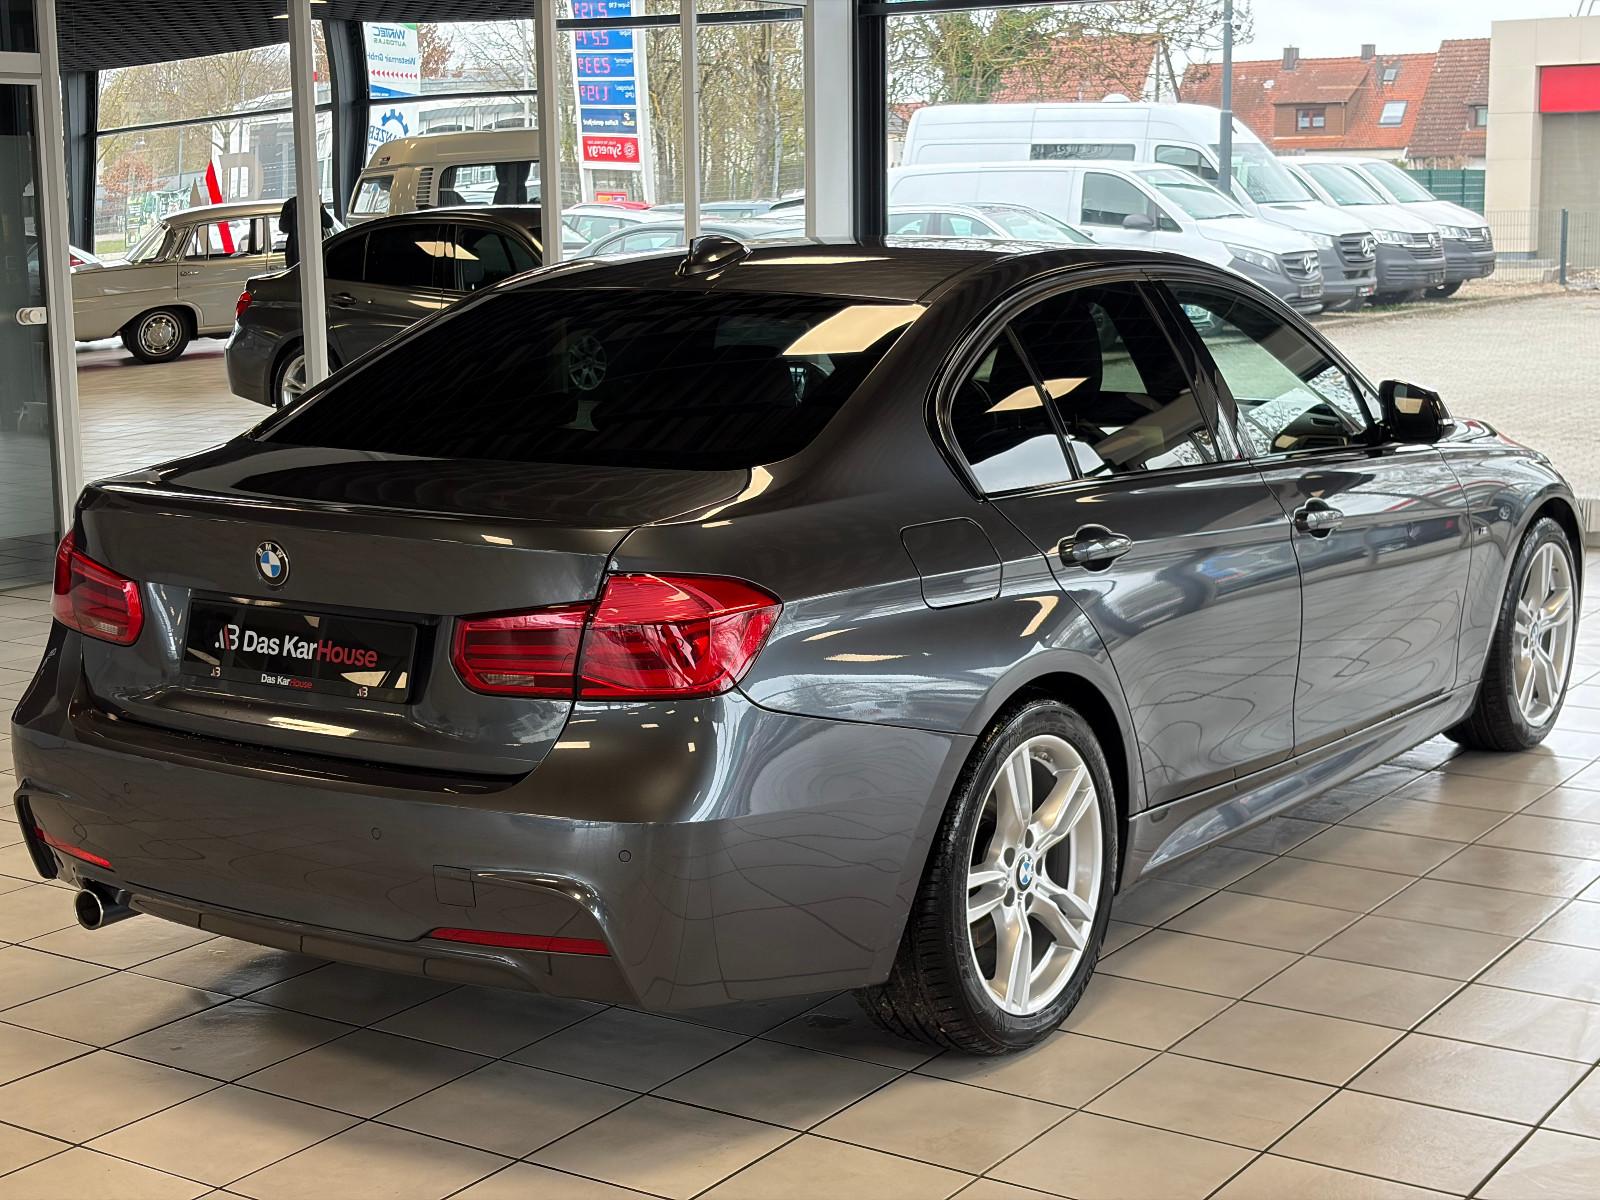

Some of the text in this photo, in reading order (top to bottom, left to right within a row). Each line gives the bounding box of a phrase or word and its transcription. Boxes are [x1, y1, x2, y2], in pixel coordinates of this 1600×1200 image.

[243, 630, 279, 655] Das
[283, 635, 378, 668] KarHouse
[261, 674, 313, 689] Das KarHouse
